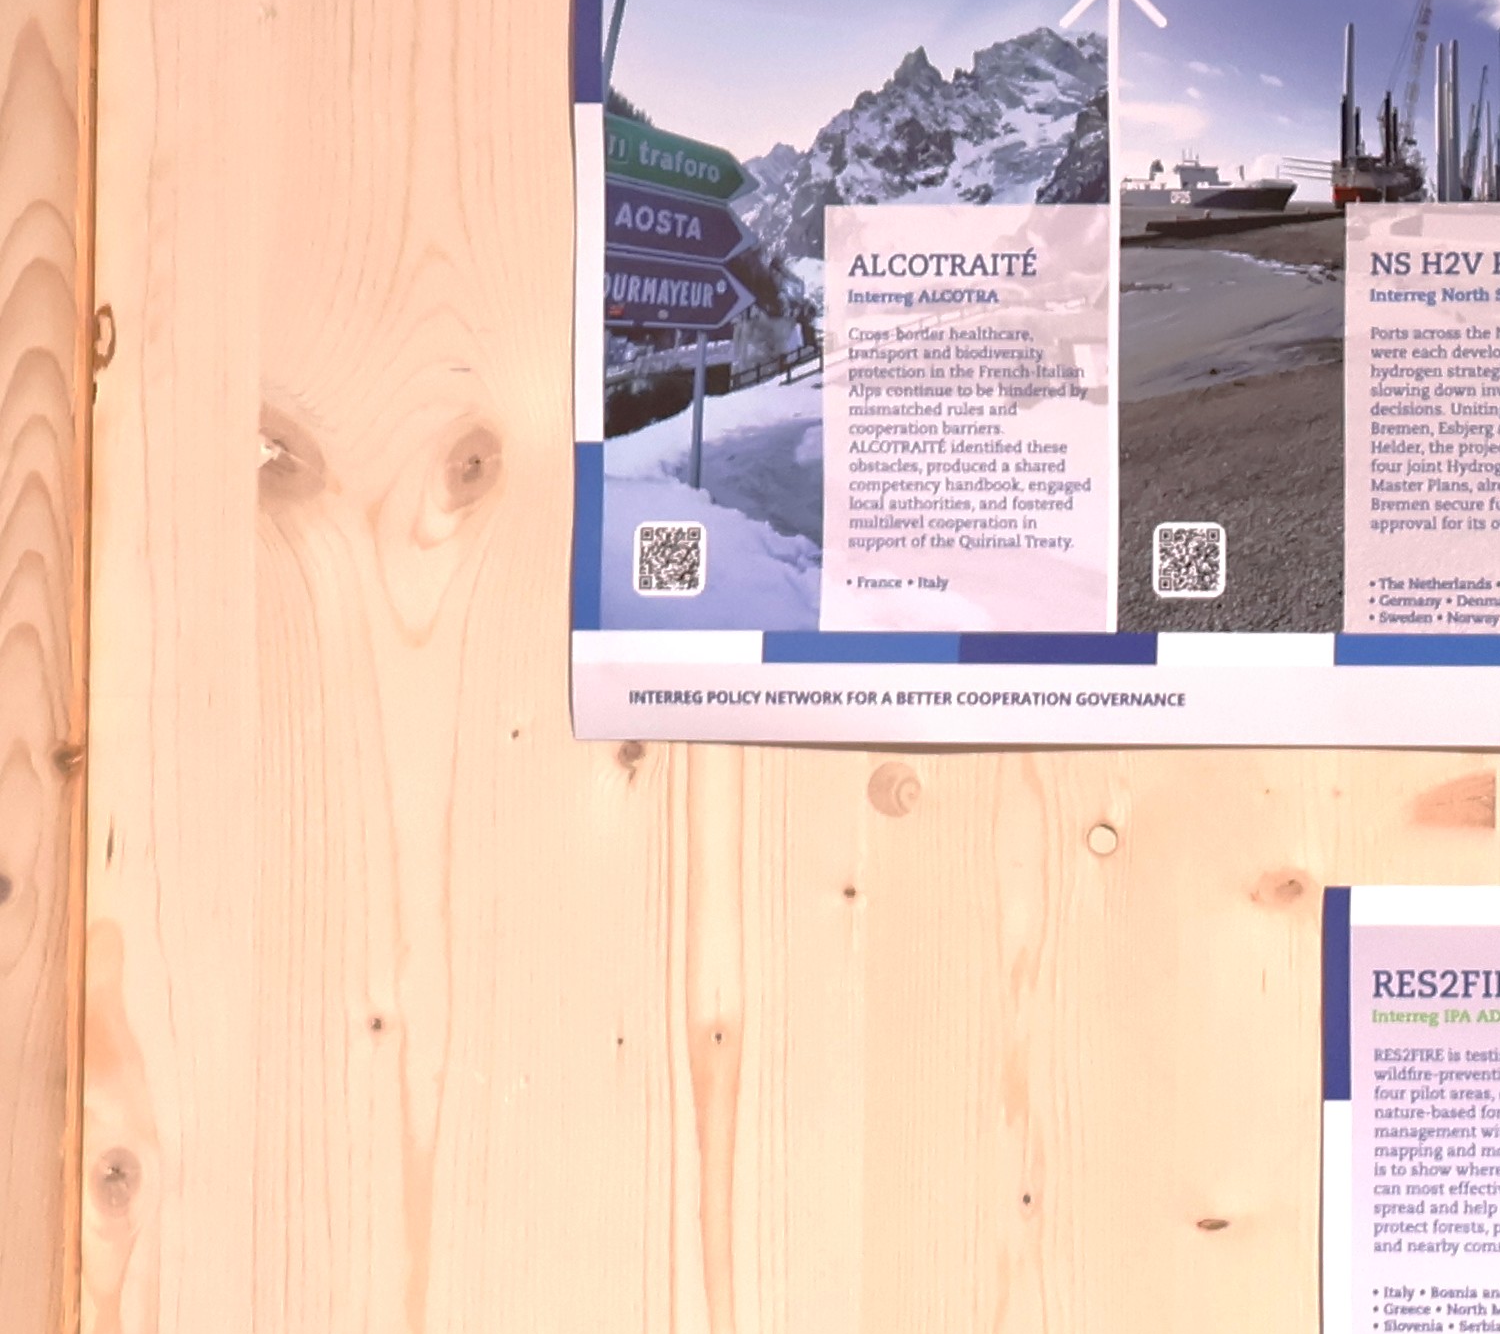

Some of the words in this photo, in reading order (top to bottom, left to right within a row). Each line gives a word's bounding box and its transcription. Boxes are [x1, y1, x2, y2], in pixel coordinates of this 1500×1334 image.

[638, 139, 721, 184] traforo
[614, 201, 703, 241] AOSTA
[847, 246, 1037, 278] ALCOTRAITÉ
[1370, 251, 1411, 277] NS
[1420, 250, 1484, 276] H2V
[628, 689, 703, 705] INTERREG
[706, 689, 762, 706] POLICY
[764, 690, 843, 705] NETWORK
[846, 690, 878, 706] FOR
[880, 690, 893, 705] A
[895, 690, 952, 706] BETTER
[955, 691, 1072, 707] COOPERATION
[1075, 691, 1185, 707] GOVERNANCE
